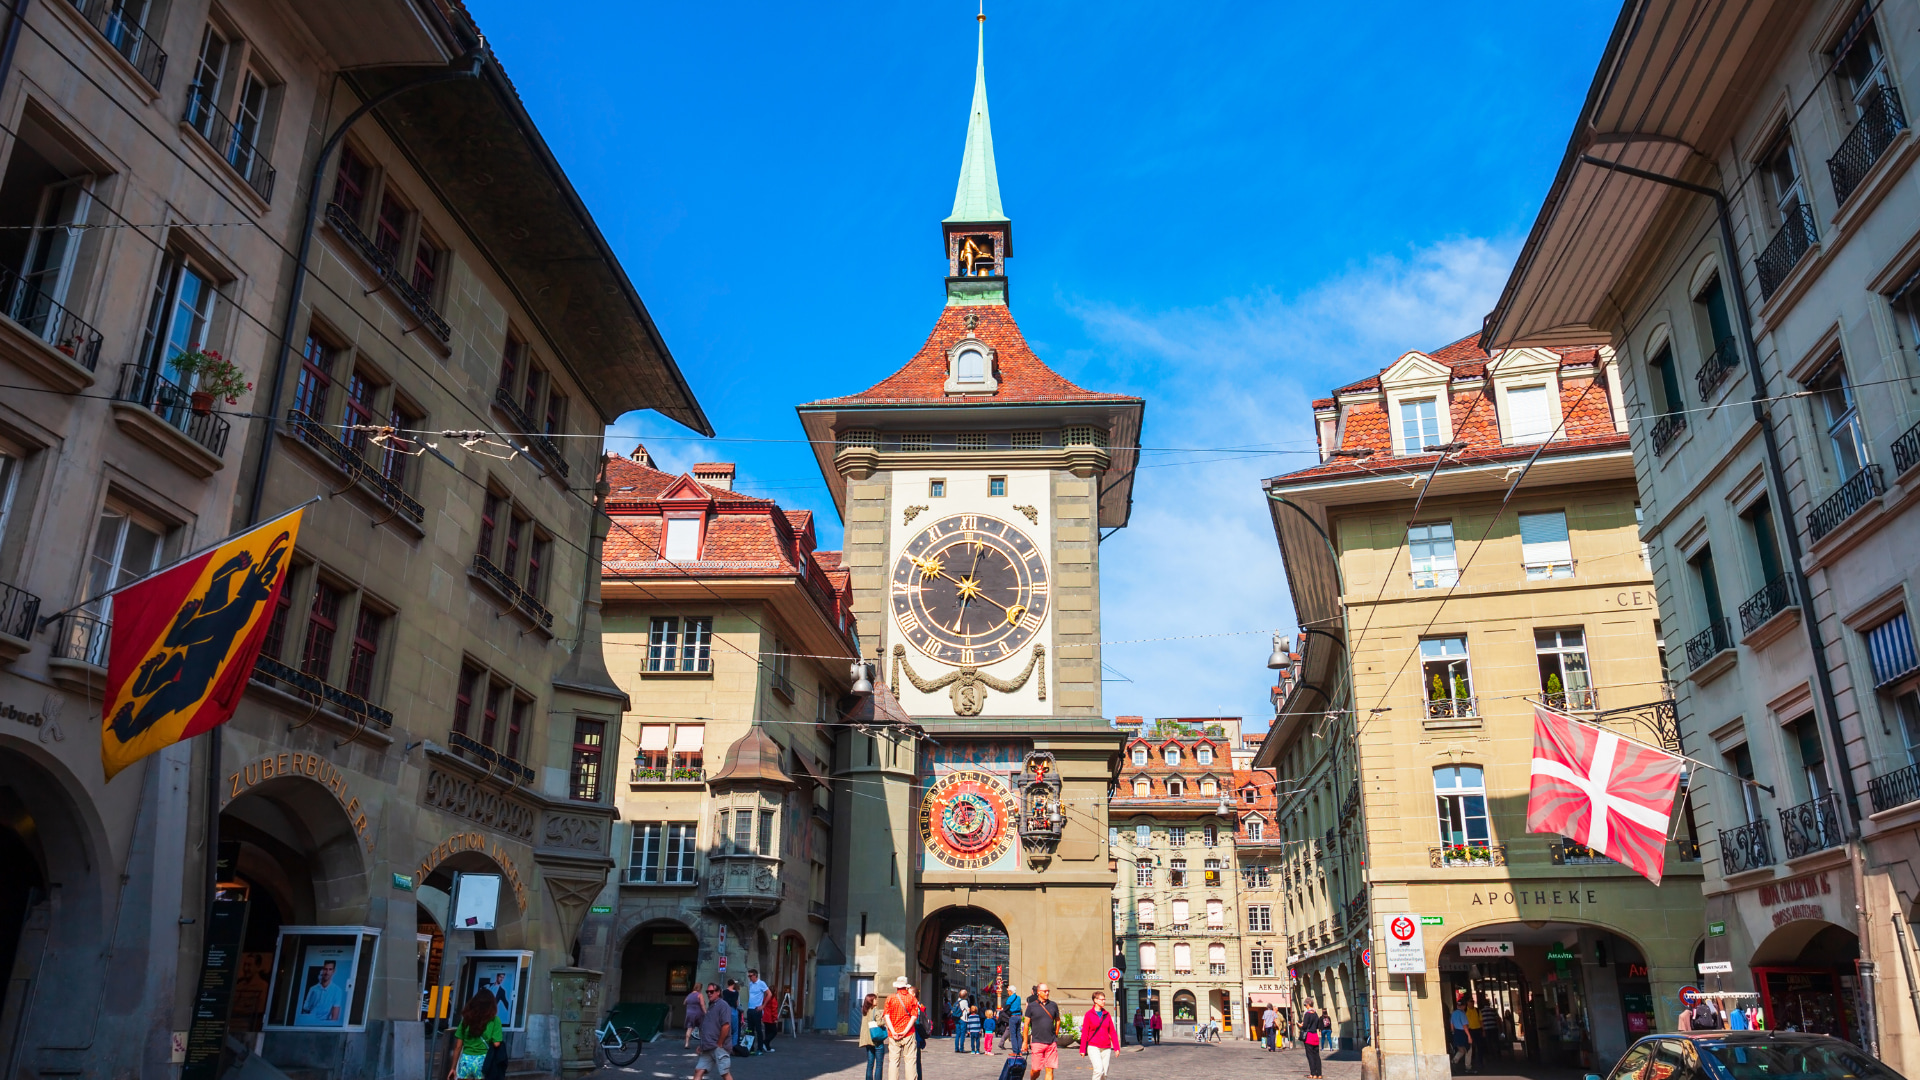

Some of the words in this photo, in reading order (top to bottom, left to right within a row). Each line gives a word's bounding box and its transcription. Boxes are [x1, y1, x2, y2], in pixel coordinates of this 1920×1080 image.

[228, 752, 368, 836] ZUBERBÜHLER
[1472, 890, 1597, 905] APOTHEKE
[1464, 945, 1500, 955] AMAVITA
[1547, 952, 1573, 960] AMAVITA
